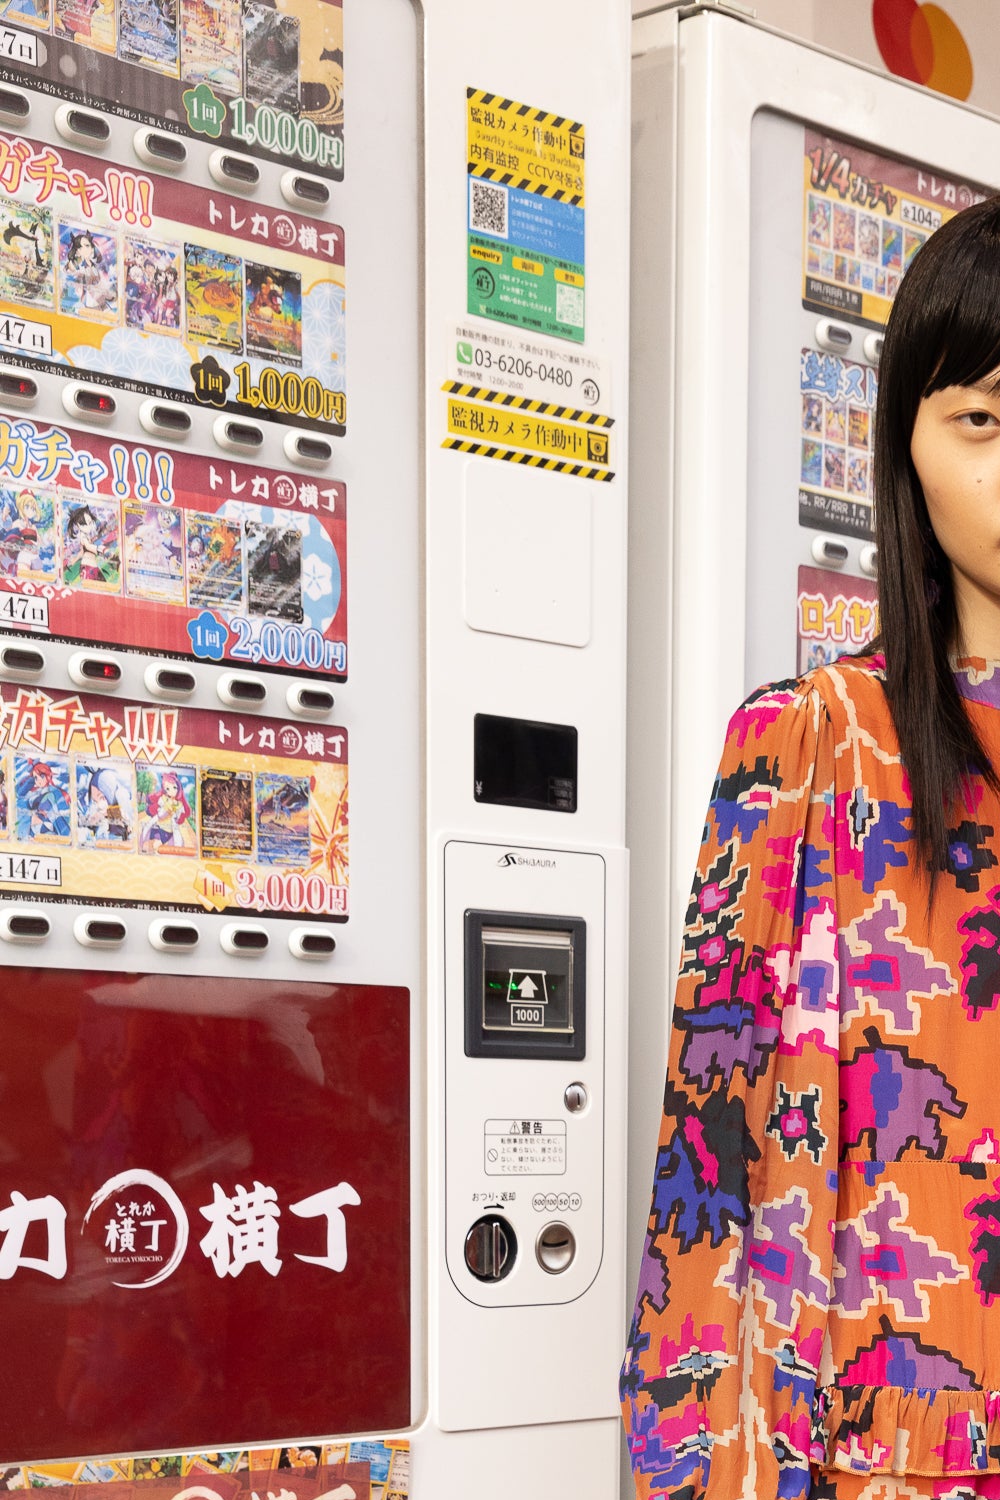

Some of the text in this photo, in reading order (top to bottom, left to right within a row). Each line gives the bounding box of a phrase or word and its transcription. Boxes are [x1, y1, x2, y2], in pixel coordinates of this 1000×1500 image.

[0, 31, 33, 60] 7口
[192, 97, 343, 169] 1回 1,000円
[471, 107, 566, 150] 監視カメラ作動中
[471, 143, 519, 171] 内有监控
[209, 200, 269, 239] トレカ
[298, 223, 339, 257] 横丁
[472, 248, 501, 263] enquiry
[475, 348, 573, 388] 03-6206-0480
[198, 361, 347, 425] 1回 1,000円
[452, 406, 582, 453] 監視カメラ作動中
[209, 465, 269, 500] トレカ
[298, 482, 339, 512] 横丁
[195, 626, 220, 649] 1回
[229, 617, 347, 672] 2,000円
[0, 690, 182, 764] ガチャ!!!
[218, 720, 276, 750] トレカ
[304, 731, 346, 758] 横丁
[0, 857, 58, 881] 147口
[204, 867, 348, 913] 1回 3,000円
[515, 1009, 540, 1023] 1000
[521, 1121, 543, 1135] 警告
[115, 1201, 156, 1217] とれか
[0, 1180, 361, 1280] カ 横丁
[105, 1218, 167, 1253] 横丁
